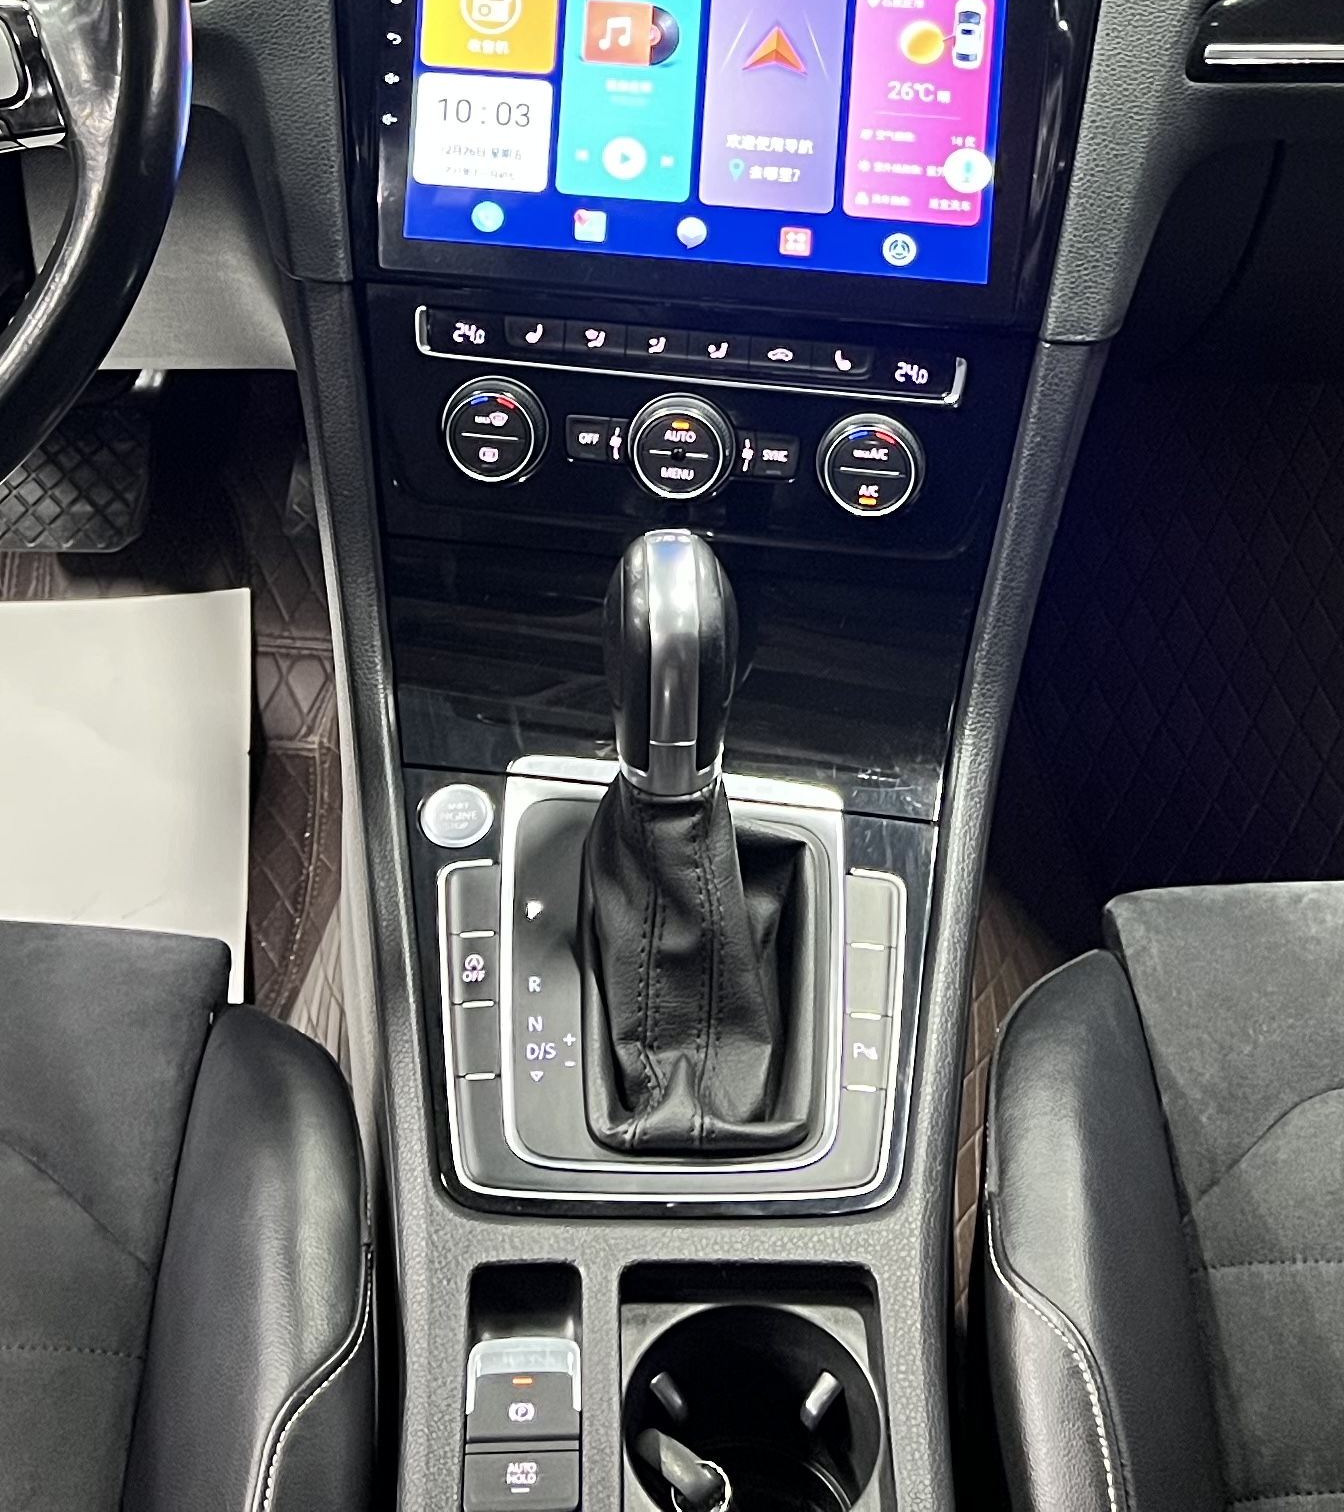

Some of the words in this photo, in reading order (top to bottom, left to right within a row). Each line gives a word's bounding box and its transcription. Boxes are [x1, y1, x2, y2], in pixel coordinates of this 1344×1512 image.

[578, 432, 600, 445] OFF
[664, 429, 697, 444] AUTO
[762, 448, 789, 463] SYNC
[660, 466, 695, 481] MENU
[462, 970, 486, 983] OFF
[528, 975, 541, 993] R
[528, 1015, 543, 1032] N
[526, 1042, 557, 1061] D/S
[506, 1461, 537, 1474] AUTO
[506, 1472, 537, 1485] HOLD
